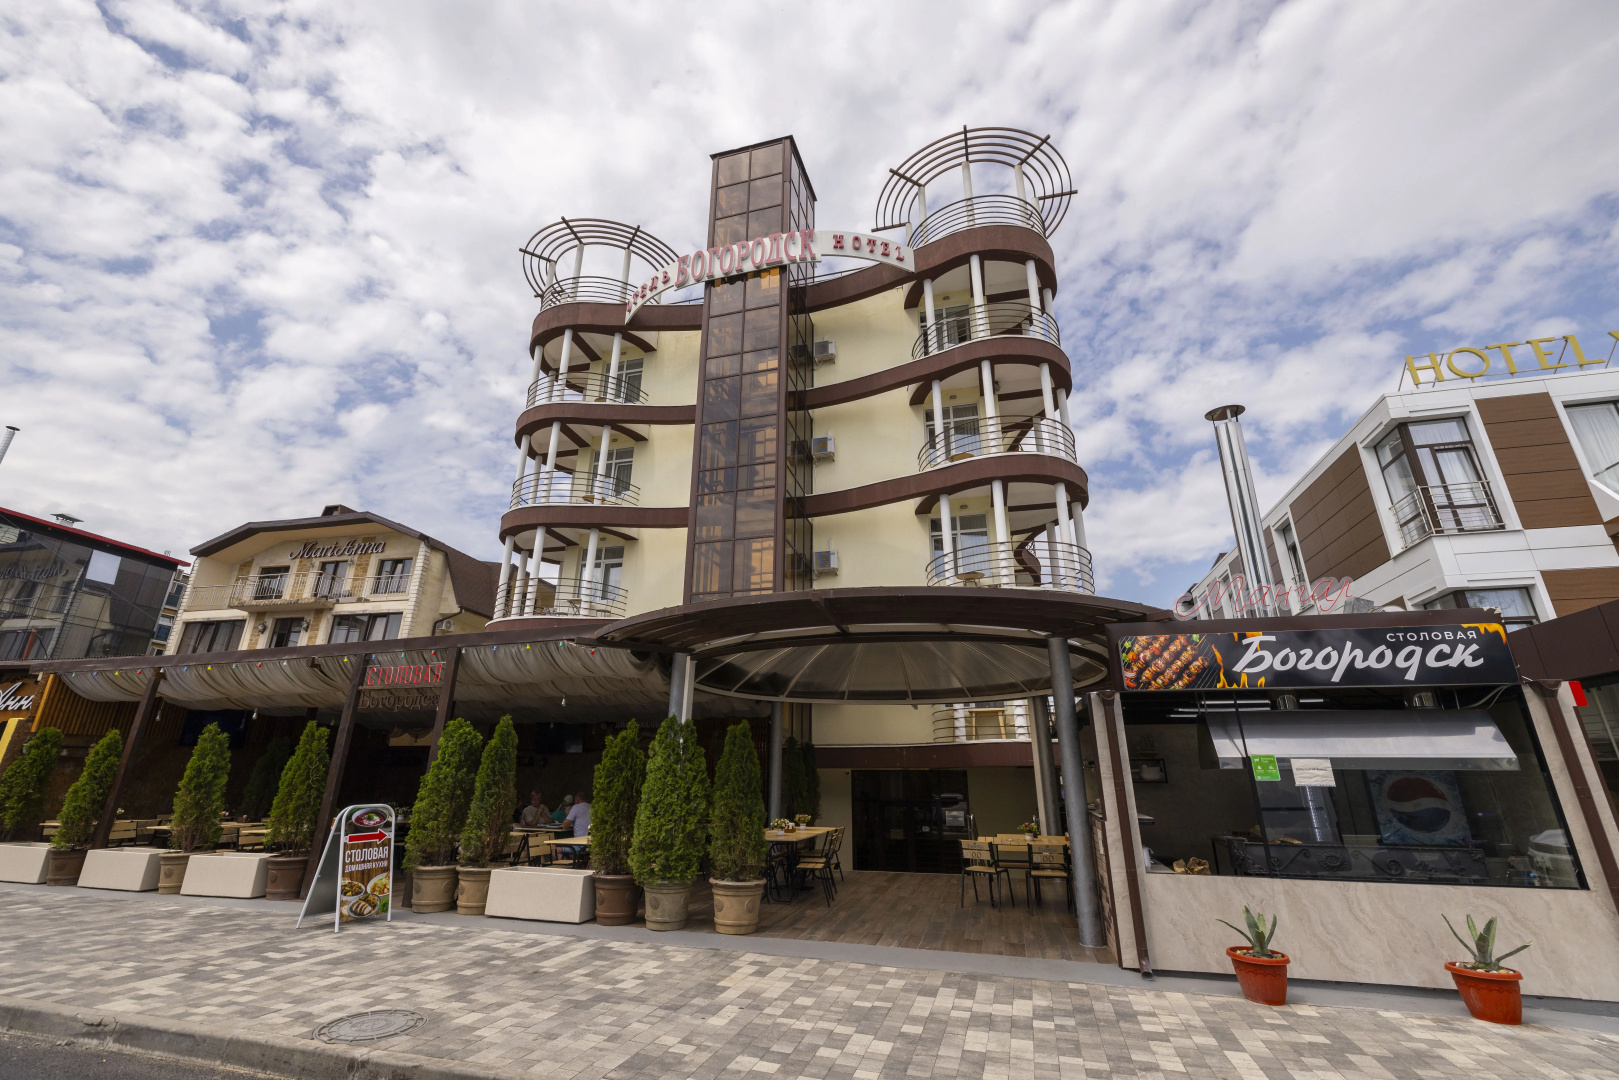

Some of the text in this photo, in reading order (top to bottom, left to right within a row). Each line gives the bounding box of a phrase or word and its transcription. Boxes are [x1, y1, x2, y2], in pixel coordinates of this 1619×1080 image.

[832, 233, 906, 262] HOTEL
[626, 228, 817, 313] ОТЕЛЬ БОГОРОДСК
[1405, 334, 1607, 386] HOTEL
[288, 539, 387, 560] MariAnna
[1175, 575, 1353, 618] Мангал
[1386, 630, 1478, 642] СТОЛОВАЯ
[1232, 635, 1484, 682] Богородск
[367, 663, 443, 686] СТОЛОВАЯ
[344, 845, 389, 863] СТОЛОВАЯ
